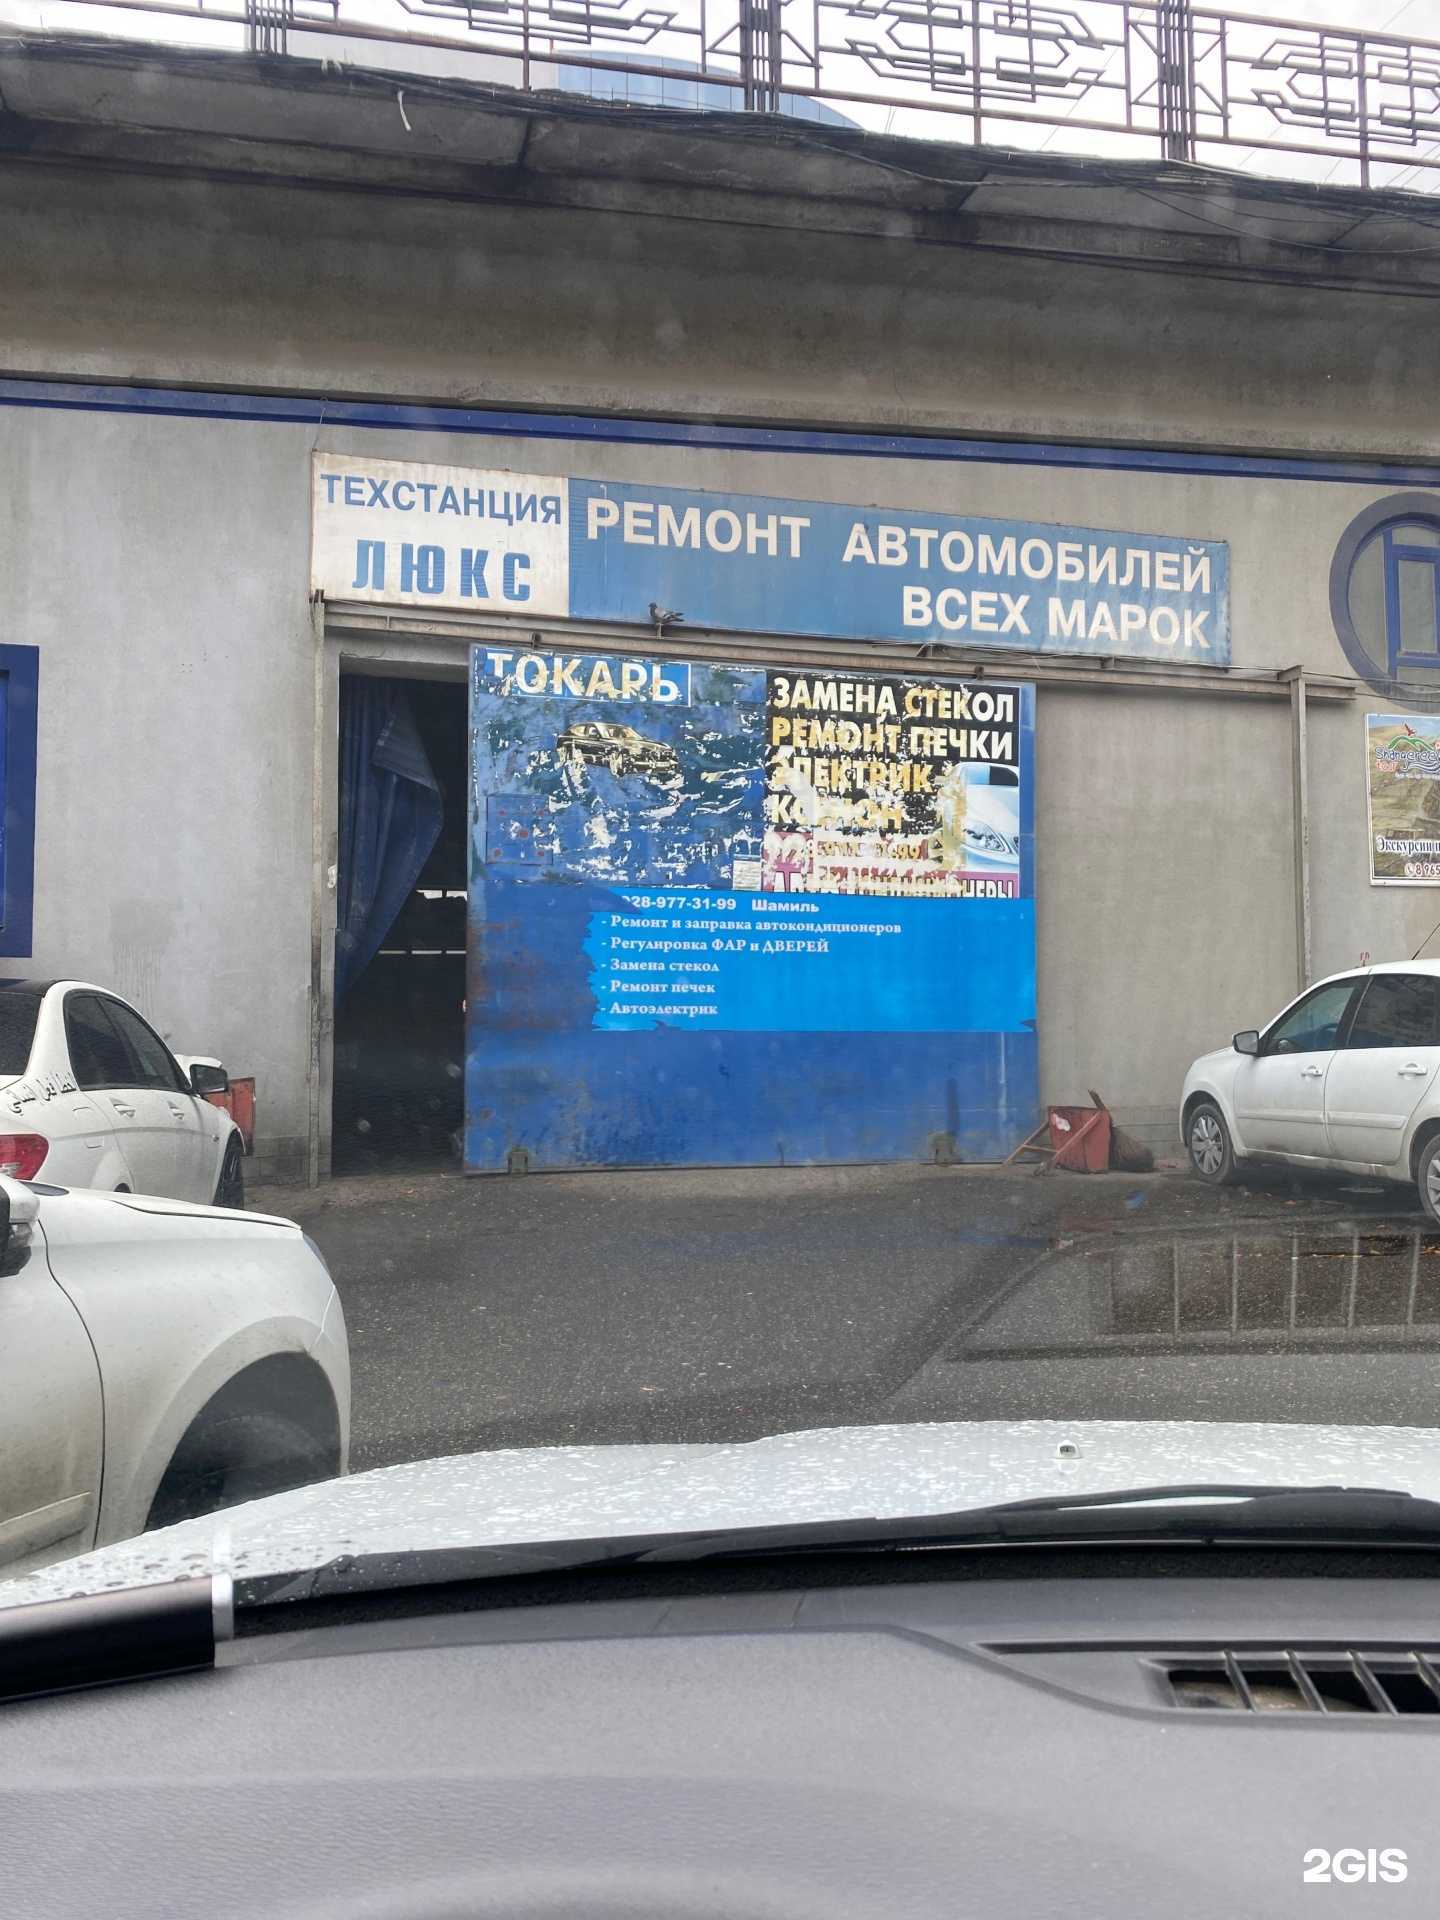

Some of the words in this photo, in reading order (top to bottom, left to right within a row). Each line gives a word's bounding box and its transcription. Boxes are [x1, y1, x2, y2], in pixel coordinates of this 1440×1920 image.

[320, 474, 561, 526] ТЕХСТАНЦИЯ
[586, 497, 811, 559] РЕМОНТ
[842, 522, 1211, 594] АВТОМОБИЛЕЙ
[352, 539, 531, 602] ЛЮКС
[903, 585, 1031, 635] ВСЕХ
[1048, 596, 1211, 649] МАРОК
[486, 652, 680, 703] ТОКАРЬ
[773, 677, 897, 715] ЗАМЕНА
[904, 688, 1014, 723] СТЕКОЛ
[772, 717, 900, 754] РЕМОНТ
[910, 726, 1013, 760] ПЕЧКИ
[611, 915, 668, 929] Ремонт
[671, 919, 682, 929] и
[685, 919, 752, 933] заправка
[755, 921, 902, 935] автокондиционеров
[751, 898, 820, 914] Шамиль
[610, 958, 665, 972] Замена
[669, 961, 720, 972] стекол
[611, 937, 708, 952] Регулировка
[712, 938, 746, 952] ФАР
[750, 942, 759, 951] и
[762, 938, 829, 954] ДВЕРЕЙ
[610, 980, 668, 993] Ремонт
[671, 982, 716, 994] печек
[610, 1002, 718, 1016] Автоэлектрик
